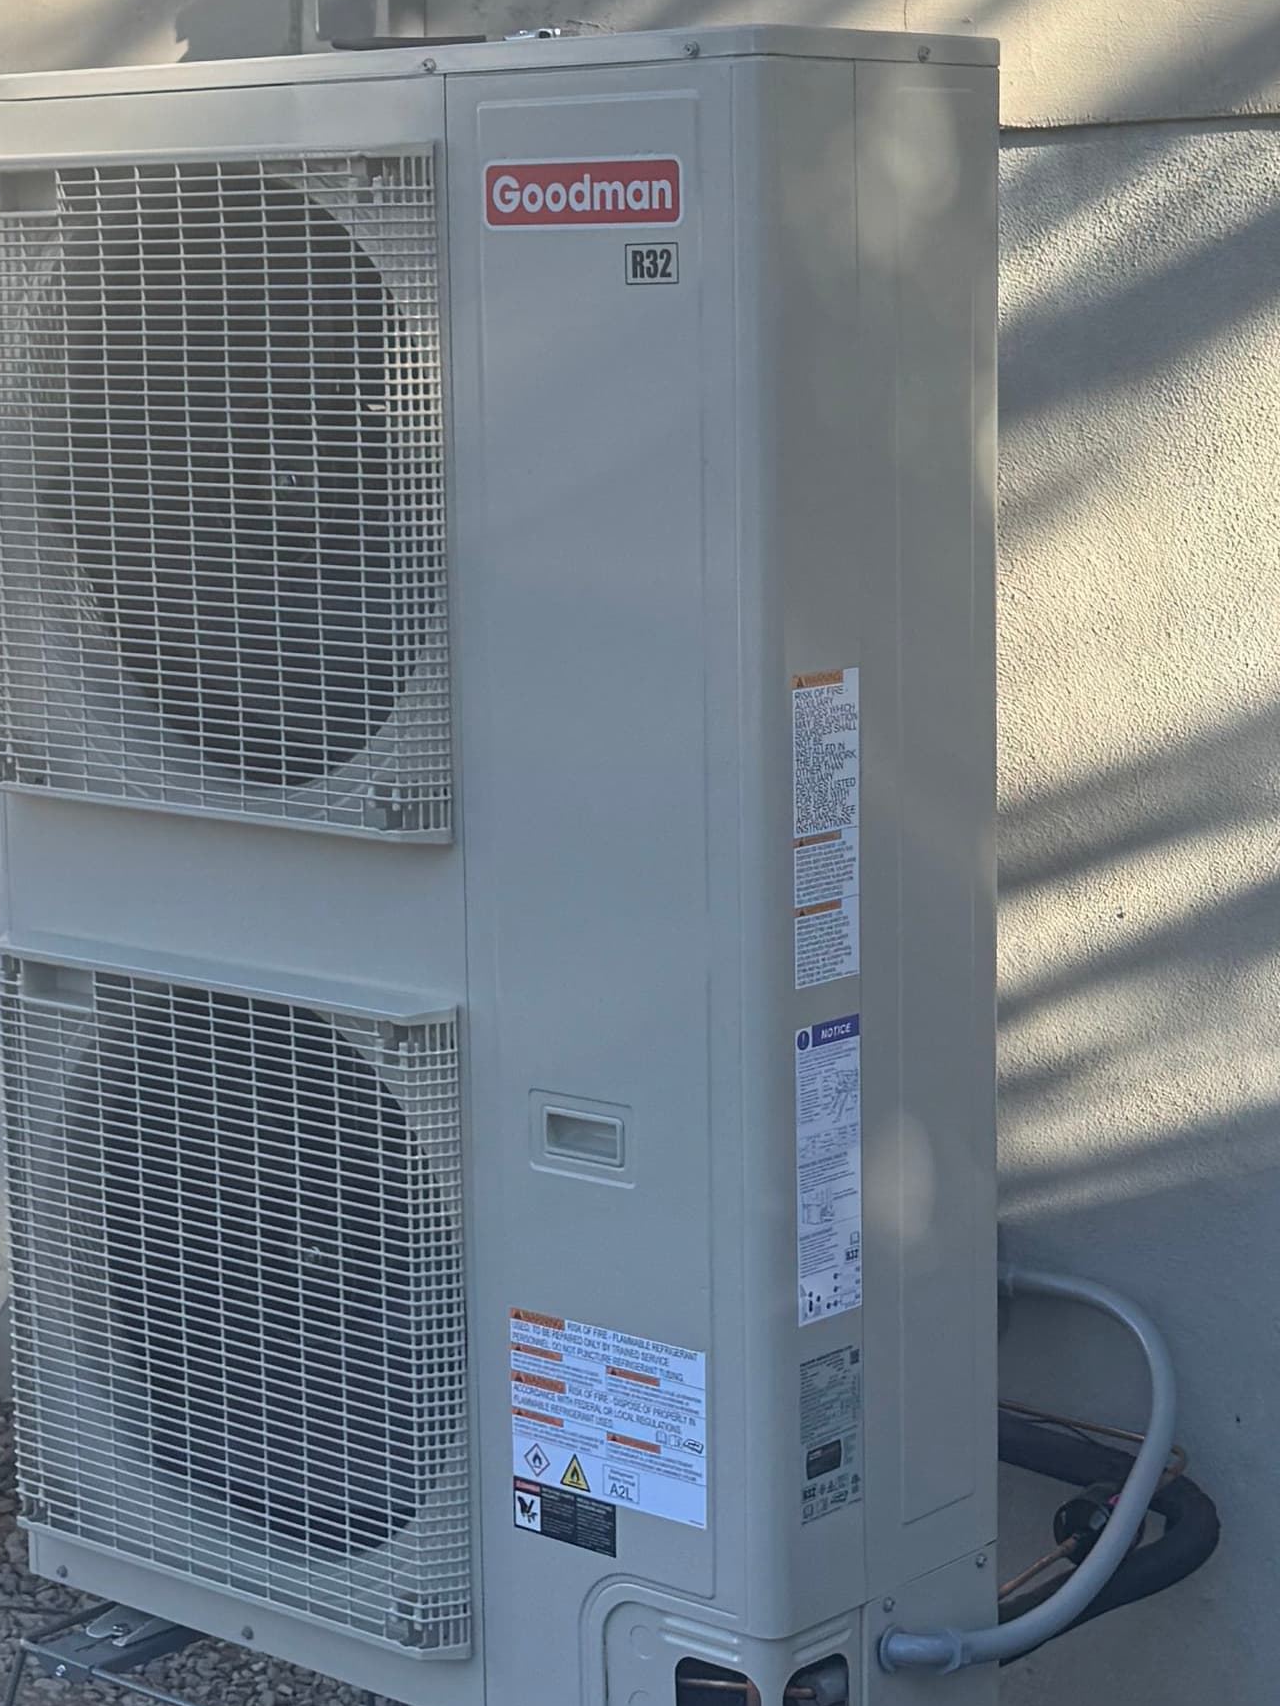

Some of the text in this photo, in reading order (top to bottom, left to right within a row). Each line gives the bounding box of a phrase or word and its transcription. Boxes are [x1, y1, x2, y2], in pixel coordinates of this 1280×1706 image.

[492, 174, 672, 213] Goodman
[631, 248, 672, 279] R32
[794, 689, 812, 700] RISK
[826, 684, 843, 696] FIRE
[834, 721, 856, 733] SHALL
[830, 777, 855, 790] LISTED
[821, 1022, 852, 1039] NOTICE
[610, 1483, 633, 1501] A2L
